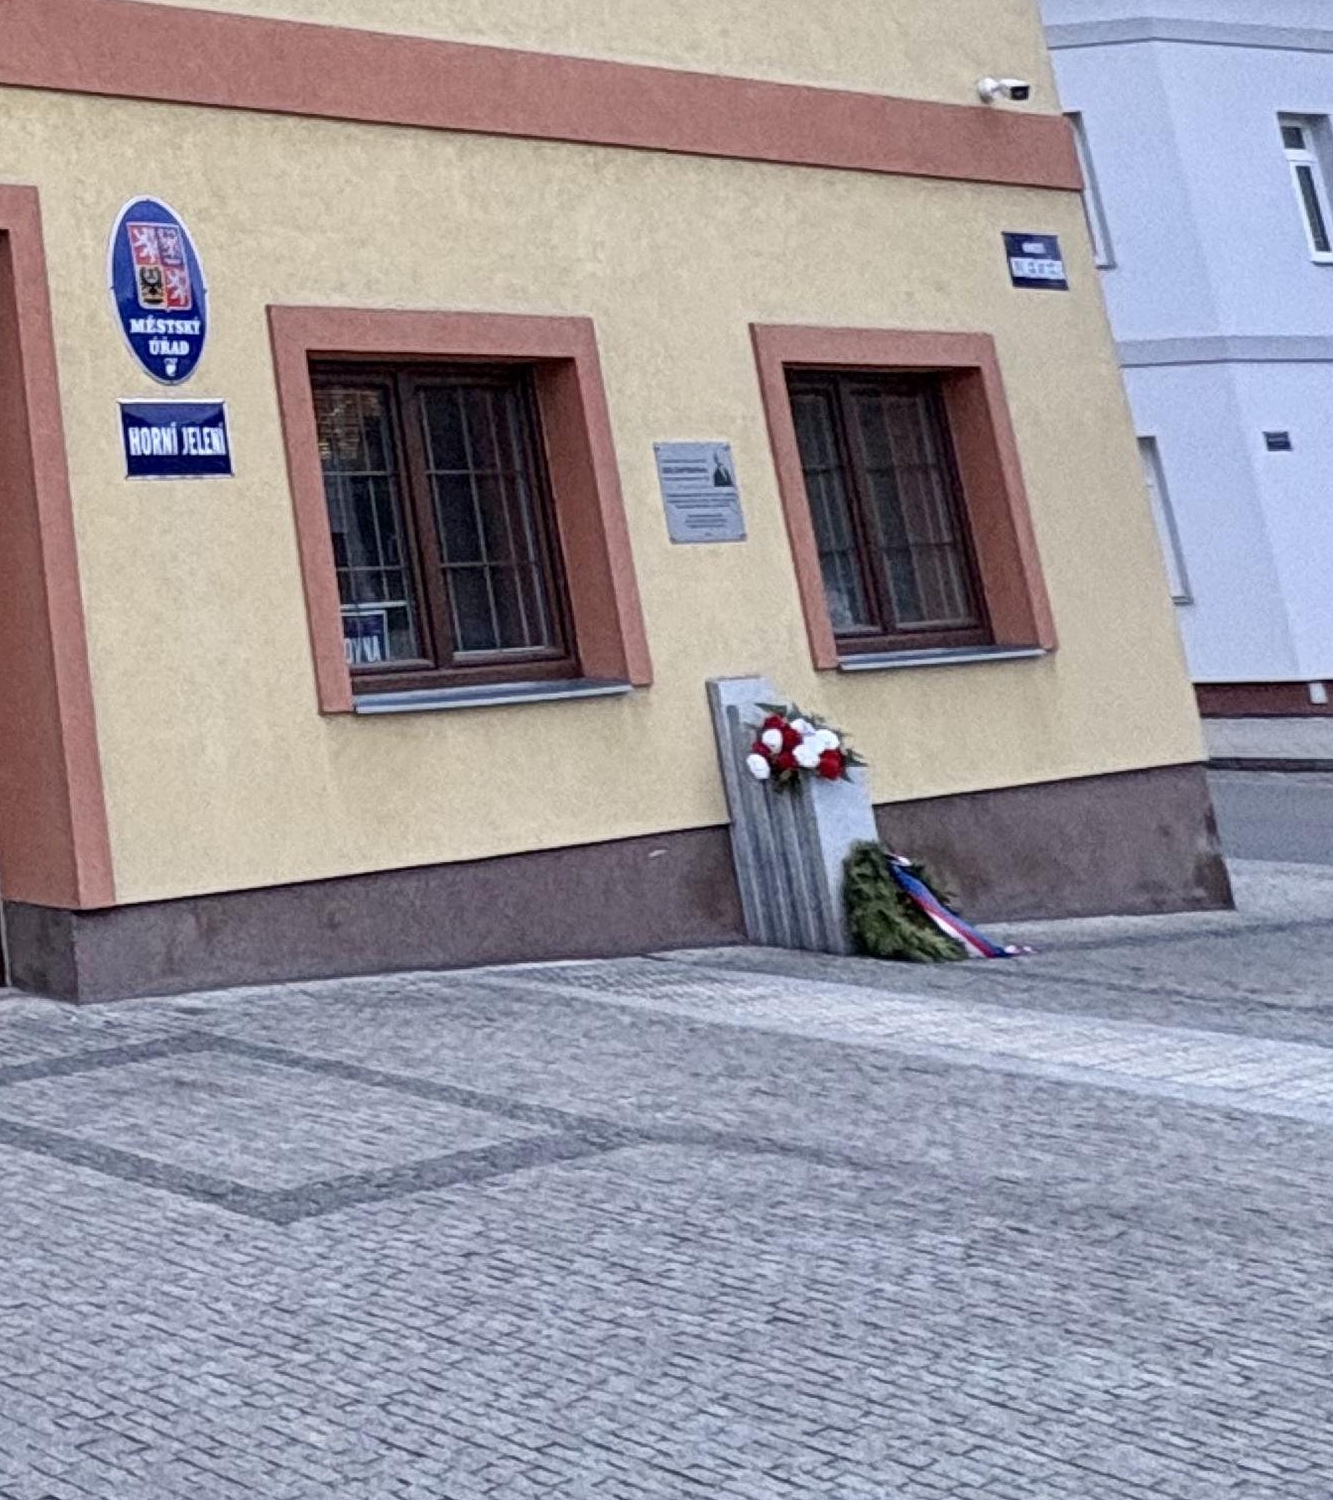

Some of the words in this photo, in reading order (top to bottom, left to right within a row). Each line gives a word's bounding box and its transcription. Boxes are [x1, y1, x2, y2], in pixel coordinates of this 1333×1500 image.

[129, 315, 201, 335] MĚSTSKÝ
[148, 336, 190, 355] ÚŘAD
[128, 421, 179, 456] HORNÍ
[181, 421, 227, 456] JELENÍ
